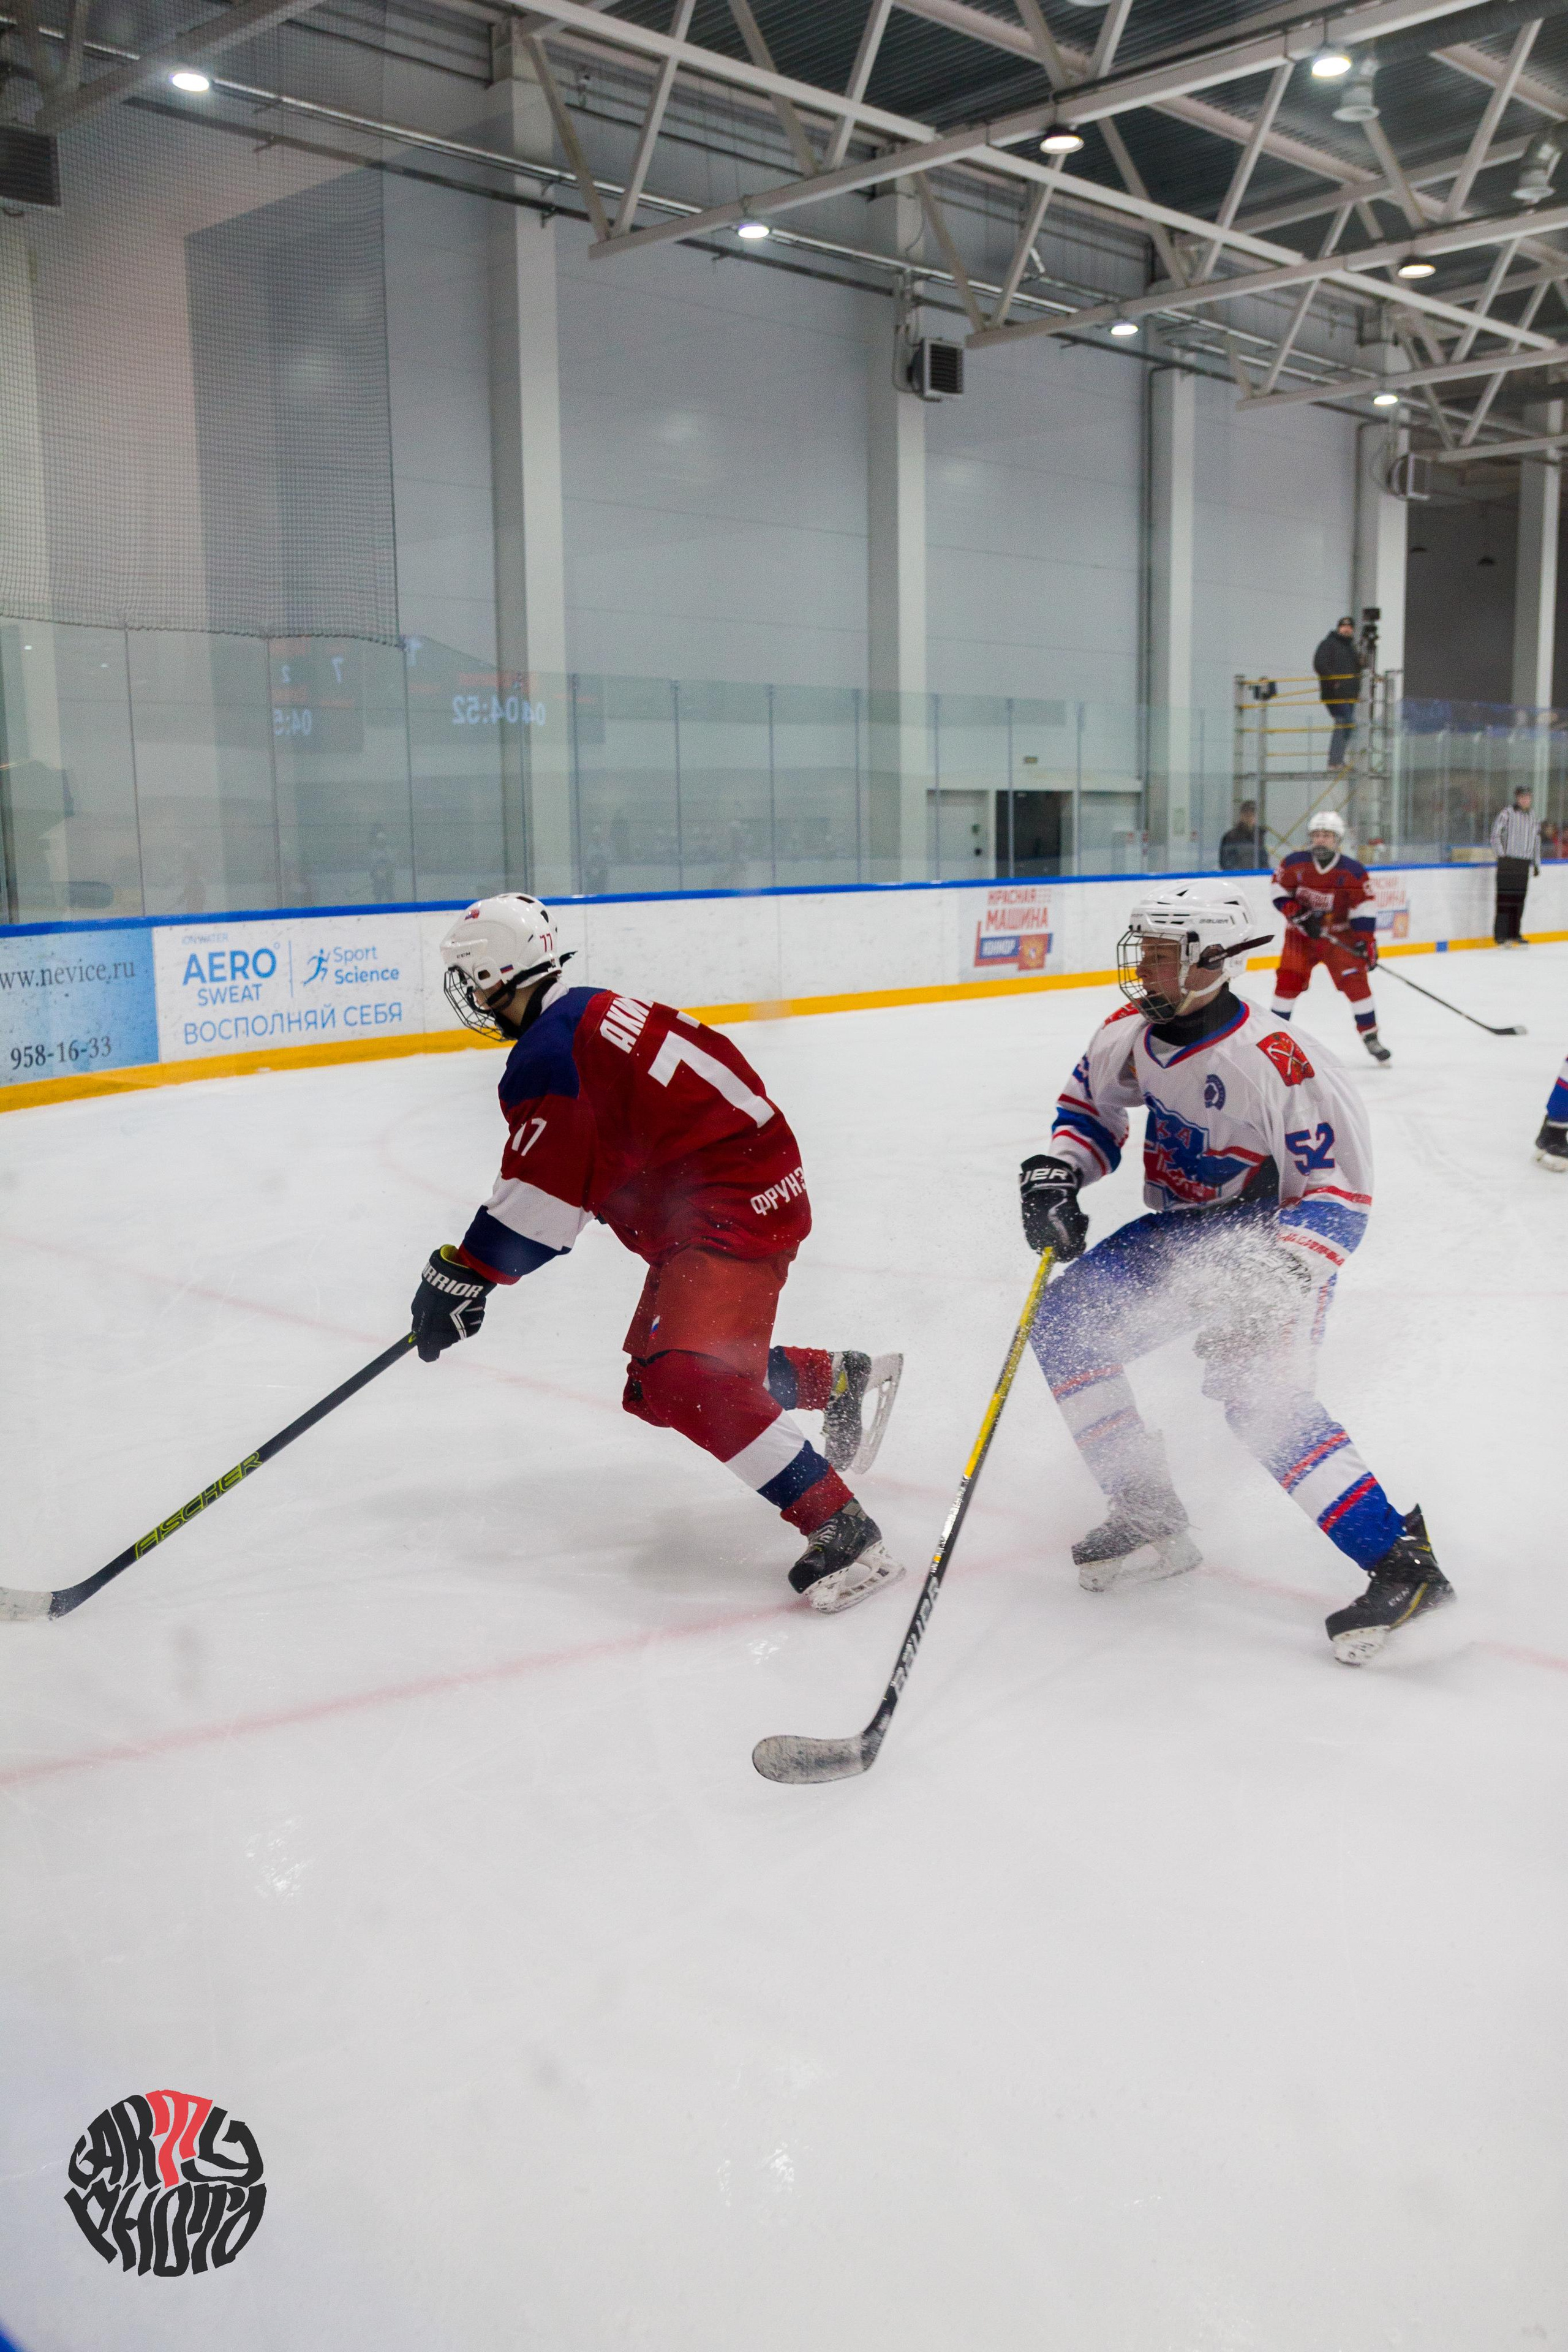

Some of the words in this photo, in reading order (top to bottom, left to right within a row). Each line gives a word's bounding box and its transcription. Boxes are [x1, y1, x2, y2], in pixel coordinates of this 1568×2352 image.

[986, 907, 1048, 931] МАШИНА
[333, 946, 378, 965] Sport
[334, 965, 400, 985] Science
[197, 983, 262, 1006] SWEAT
[184, 1003, 336, 1045] ВОСПОЛНЯЙ
[344, 1002, 402, 1027] СЕБЯ
[600, 997, 654, 1054] АКИ
[10, 1036, 111, 1071] 958-16-33
[647, 1010, 775, 1129] 7
[1285, 1122, 1335, 1176] 52
[423, 1262, 484, 1298] RRIOR
[135, 1451, 263, 1561] FISCHER
